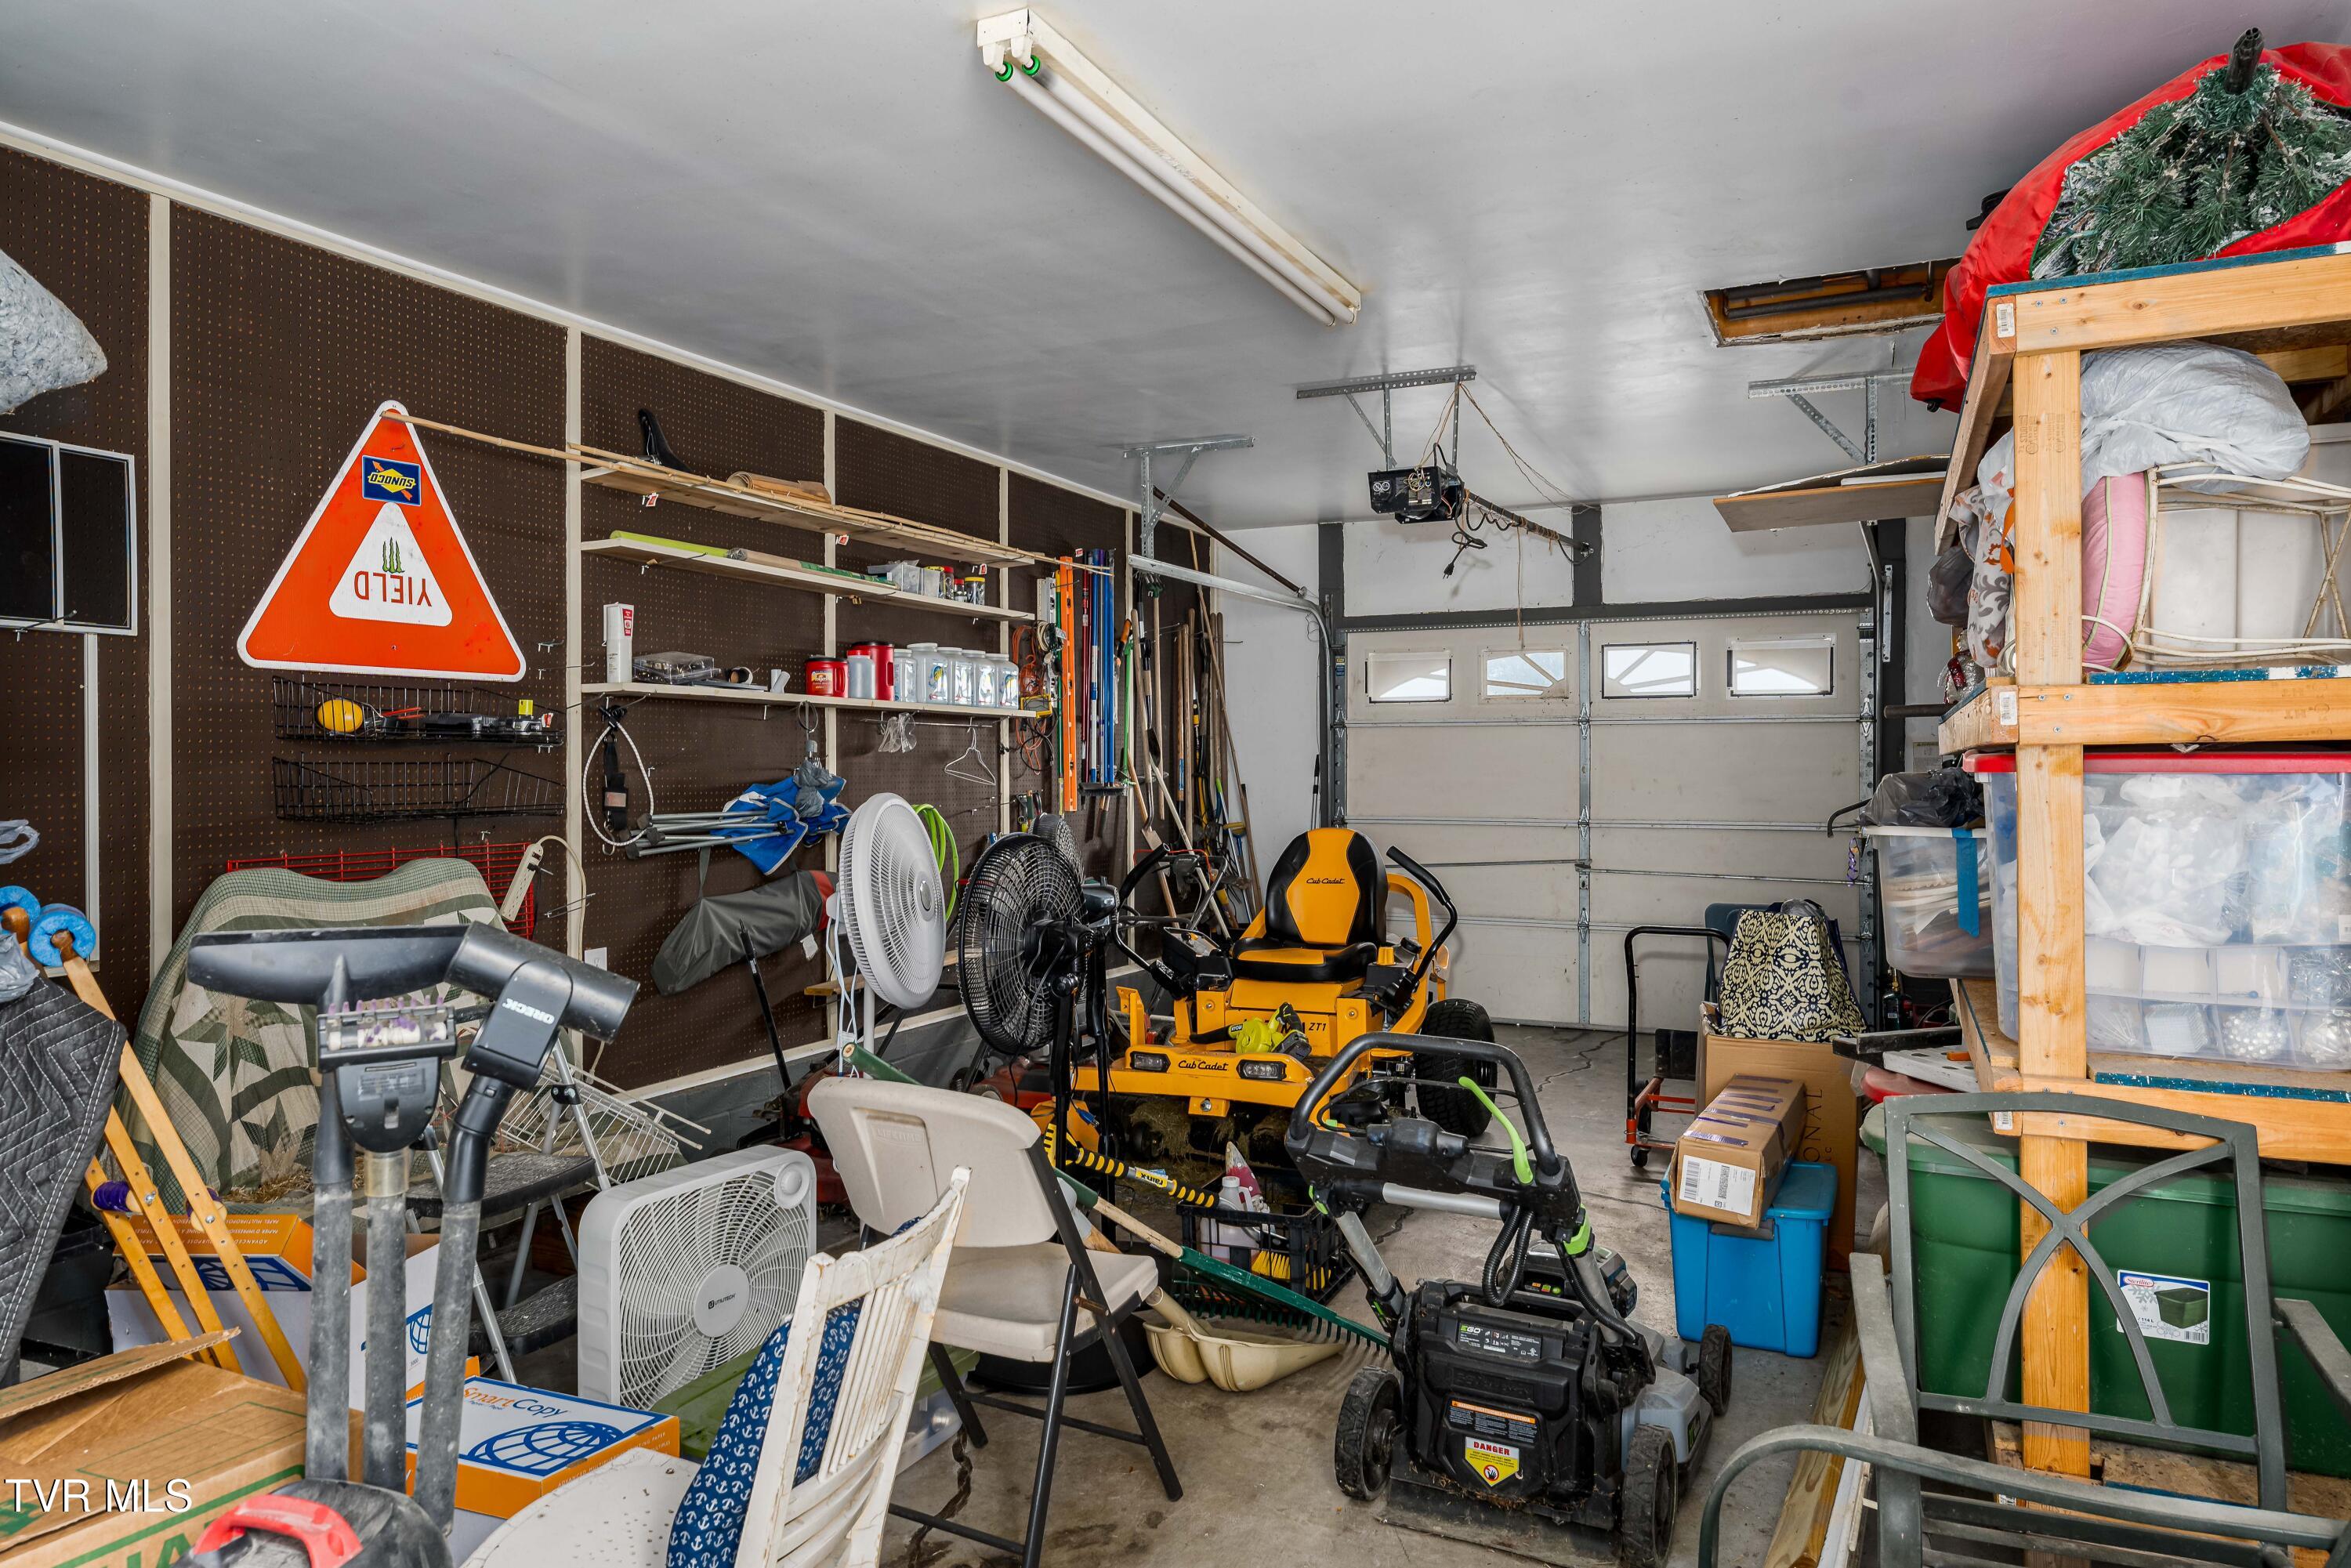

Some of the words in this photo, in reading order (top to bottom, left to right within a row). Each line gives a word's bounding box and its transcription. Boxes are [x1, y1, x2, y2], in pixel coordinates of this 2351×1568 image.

[370, 473, 414, 488] SUNOCO
[353, 570, 433, 607] YIELD
[502, 998, 555, 1025] ORECK
[1308, 1022, 1327, 1032] ZT1
[1178, 1059, 1197, 1069] Cub
[1197, 1060, 1229, 1071] Cadet
[2127, 1277, 2153, 1286] Sterilite
[1460, 1325, 1481, 1334] EGO
[1473, 1441, 1510, 1456] DANGER
